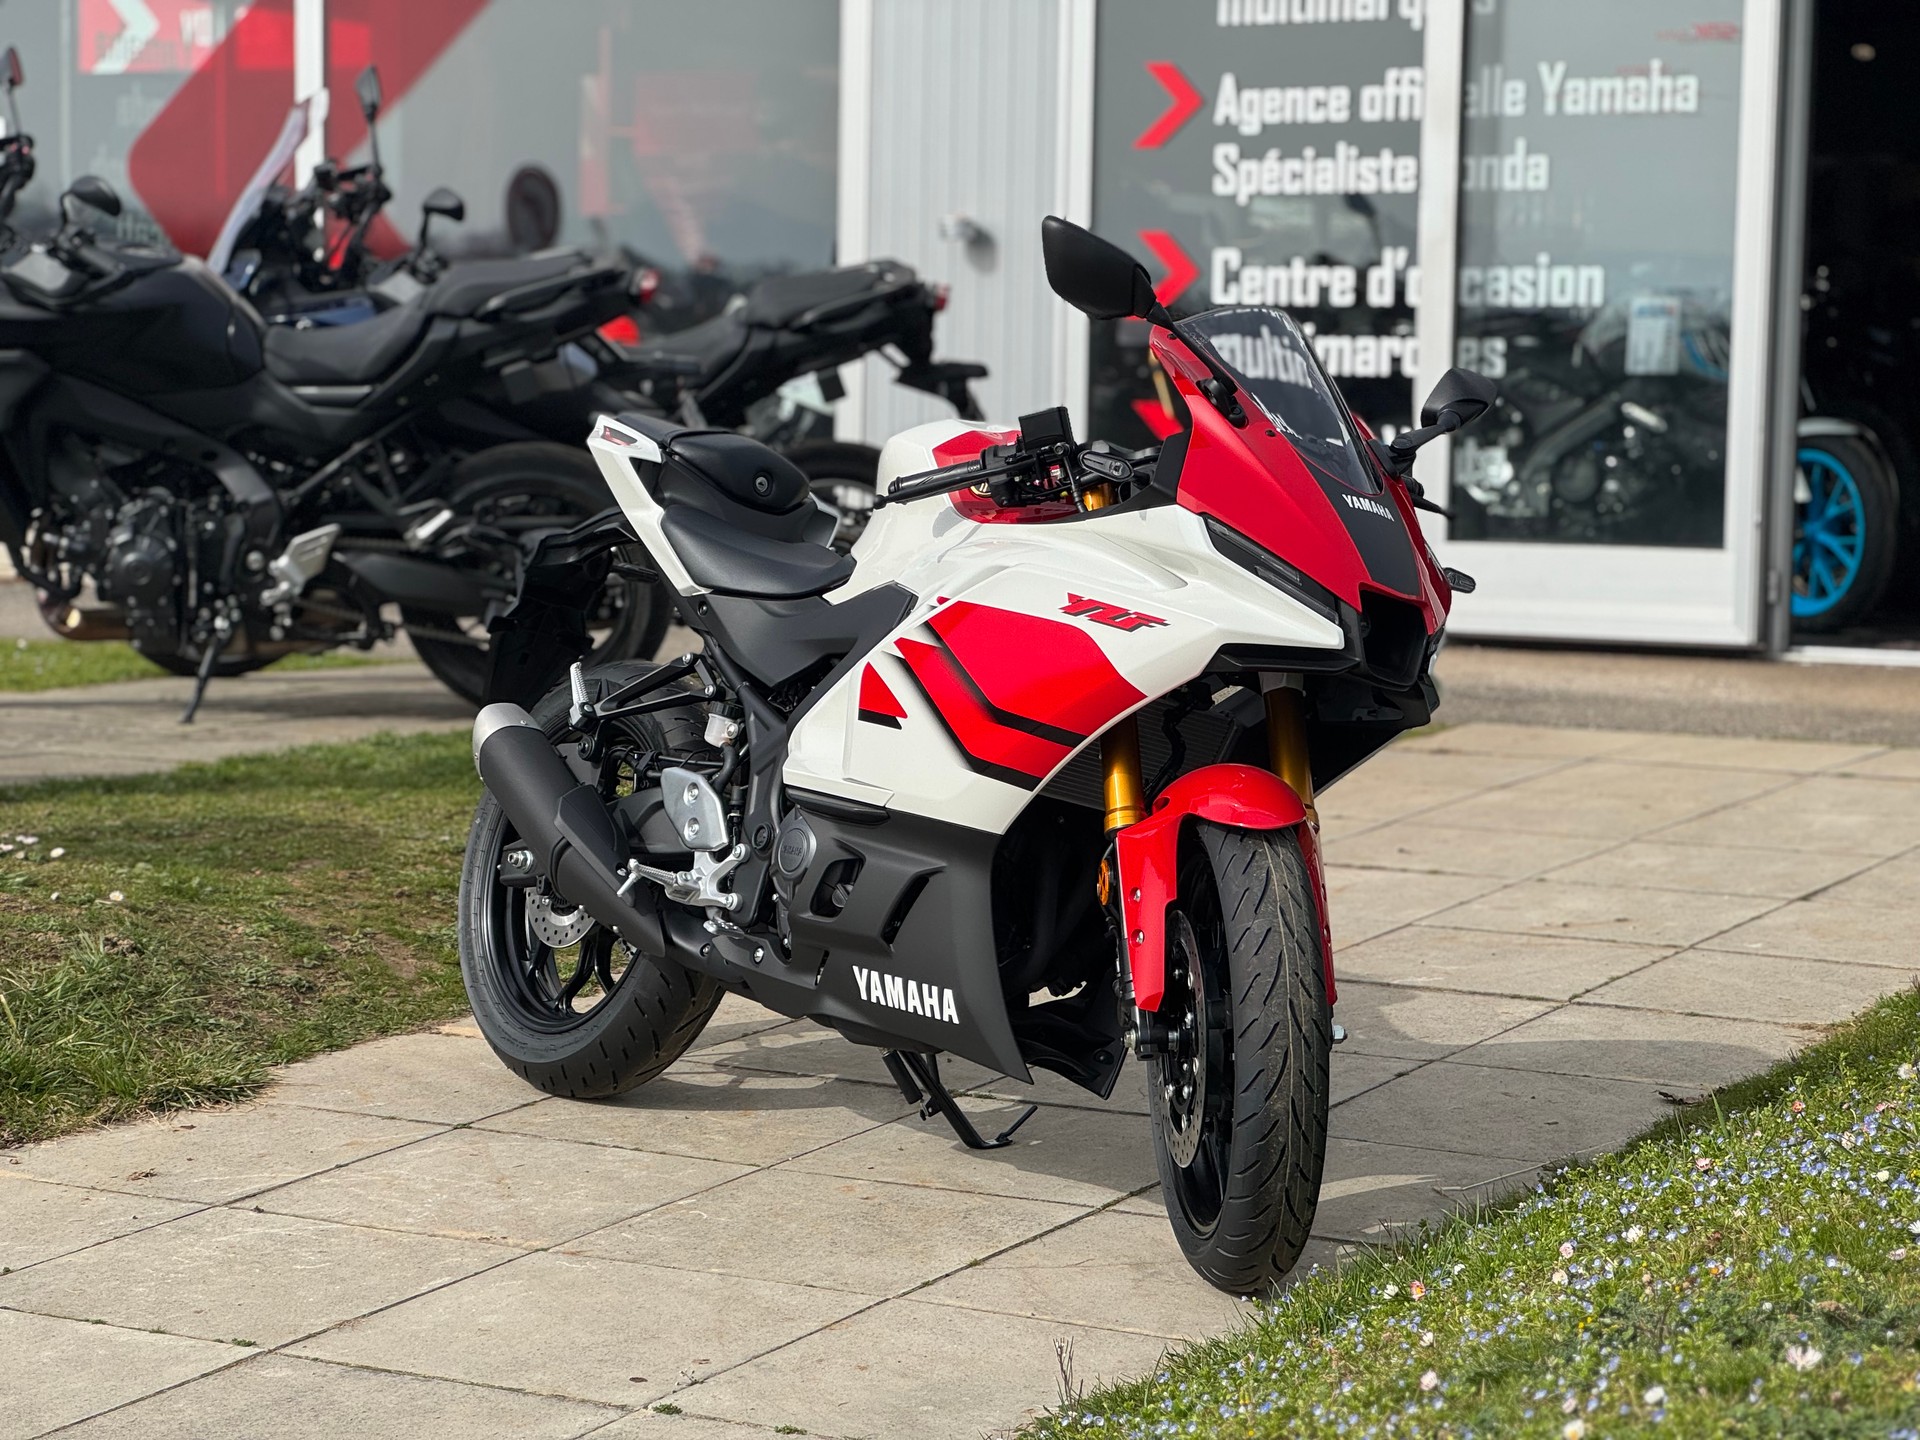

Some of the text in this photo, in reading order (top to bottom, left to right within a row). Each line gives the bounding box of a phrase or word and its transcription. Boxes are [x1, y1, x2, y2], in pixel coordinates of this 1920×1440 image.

[1213, 72, 1351, 136] Agence
[1537, 58, 1699, 116] Yamaha
[1212, 140, 1418, 207] Spécialiste
[1210, 246, 1605, 308] Centre d'ocasion
[1341, 493, 1395, 522] YAMAHA
[852, 965, 960, 1025] YAMAHA
